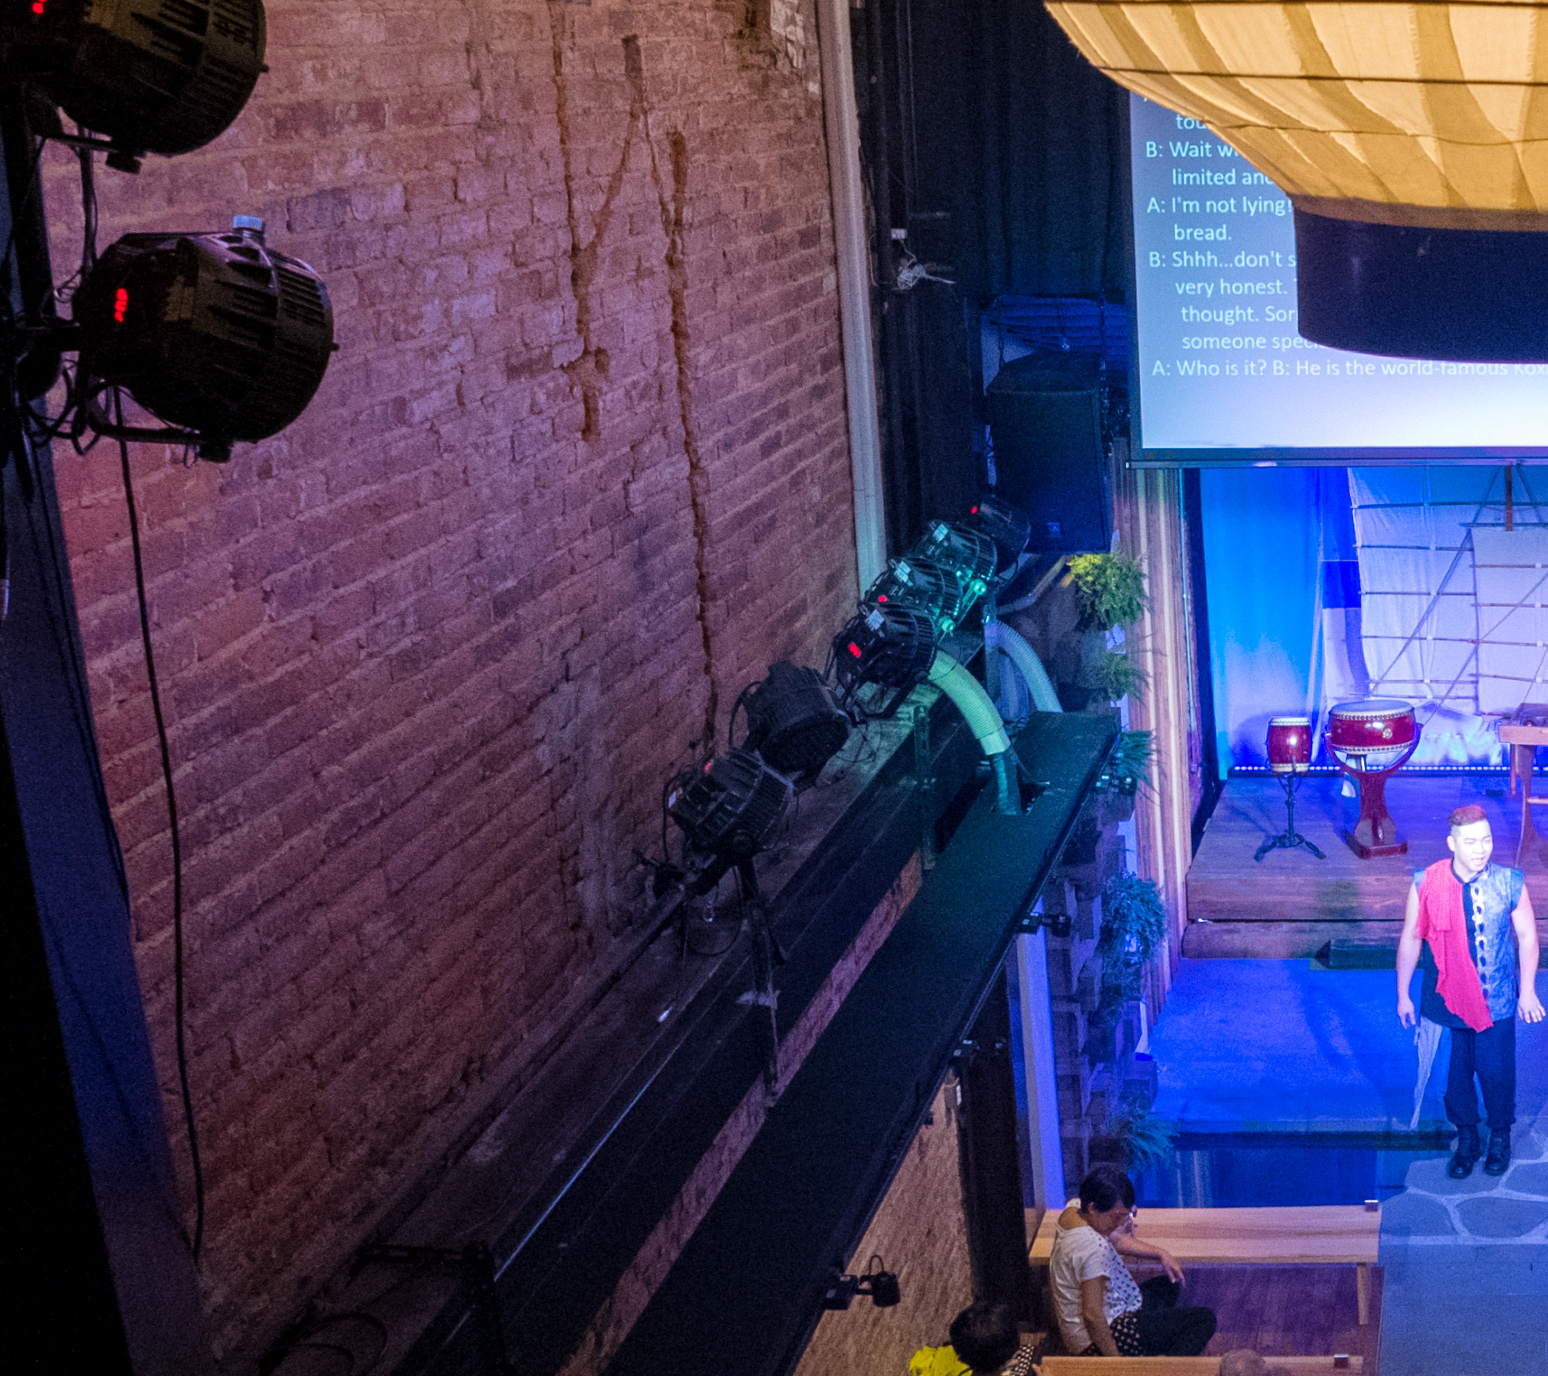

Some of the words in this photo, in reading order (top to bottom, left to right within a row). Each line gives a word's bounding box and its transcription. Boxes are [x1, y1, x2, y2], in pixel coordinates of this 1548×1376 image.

[1176, 115, 1207, 130] tou
[1146, 141, 1163, 157] B:
[1169, 141, 1212, 157] Wait
[1217, 144, 1239, 157] w
[1172, 169, 1236, 185] limited
[1147, 197, 1165, 213] A:
[1172, 197, 1200, 213] I'm
[1206, 198, 1236, 213] not
[1242, 196, 1293, 216] lying!
[1174, 224, 1232, 241] bread.
[1149, 251, 1166, 267] B:
[1172, 250, 1282, 268] Shhh...don't
[1175, 282, 1214, 298] very
[1220, 278, 1288, 295] honest.
[1181, 305, 1259, 326] thought.
[1264, 305, 1295, 322] Sor
[1182, 335, 1267, 349] someone
[1152, 360, 1171, 375] A:
[1176, 359, 1220, 376] Who
[1225, 359, 1238, 376] is
[1244, 359, 1267, 376] it?
[1273, 360, 1290, 376] B:
[1296, 360, 1320, 376] He
[1327, 360, 1340, 376] is
[1345, 360, 1376, 376] the
[1381, 361, 1508, 376] world-famous
